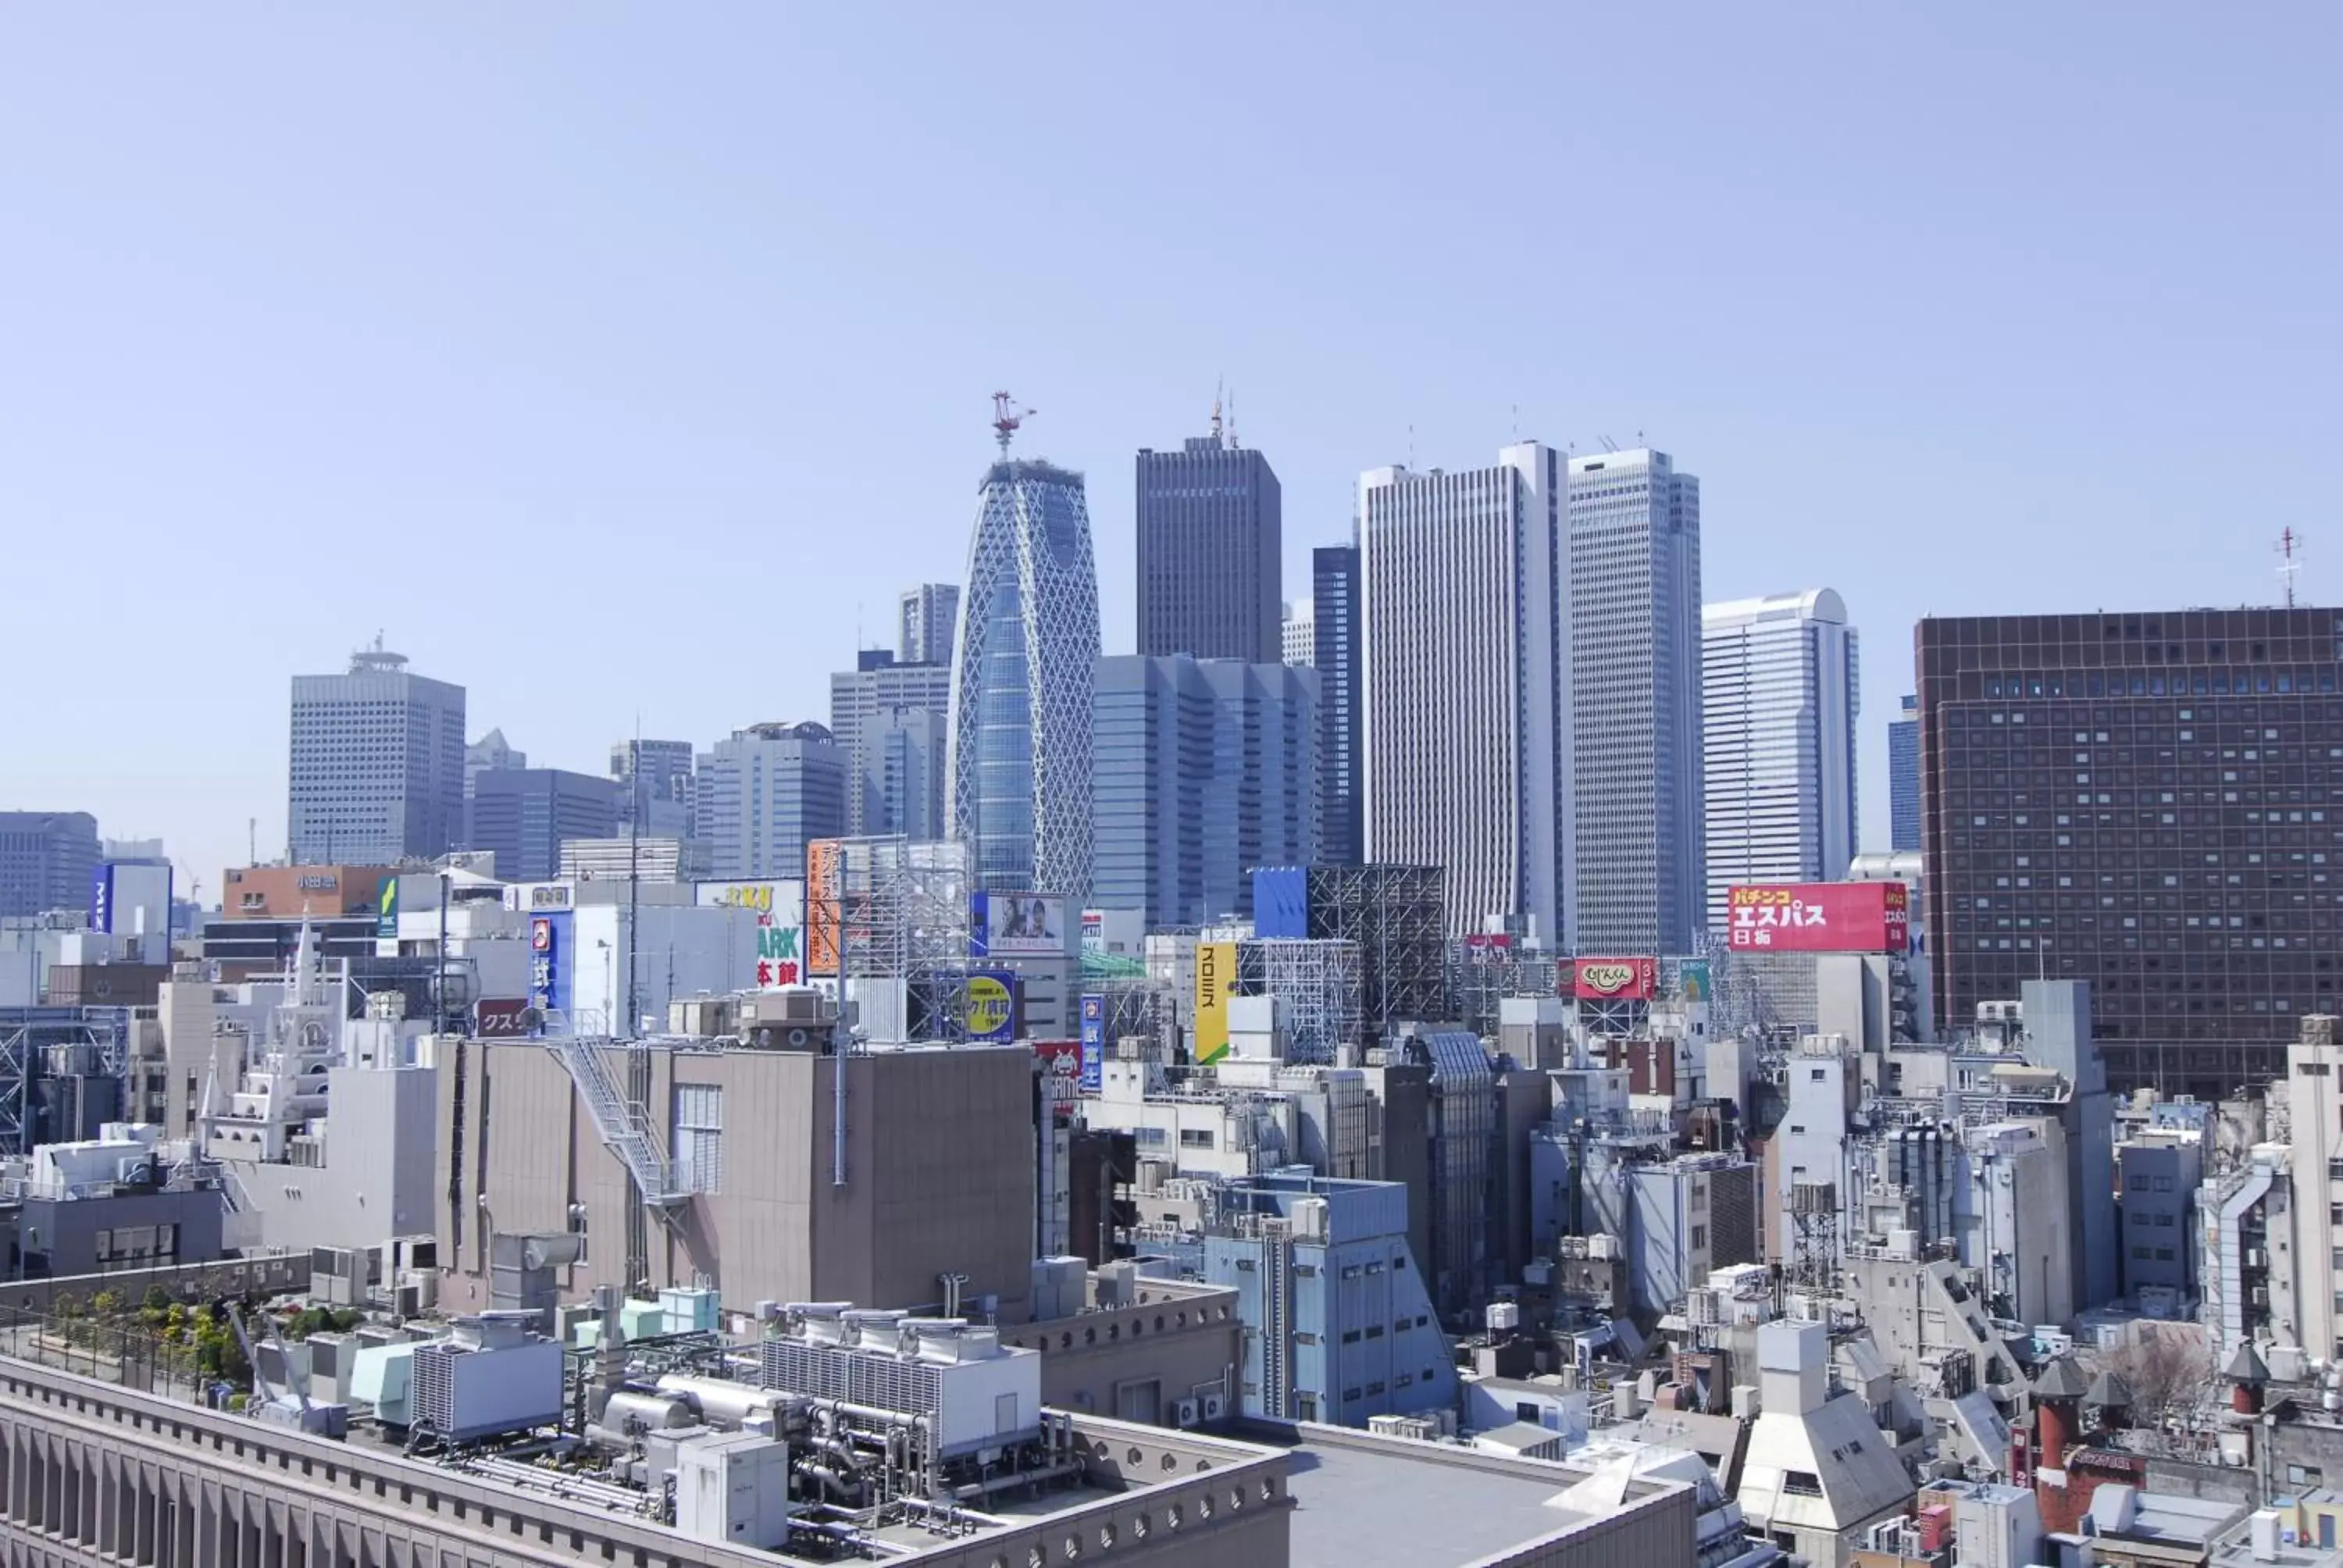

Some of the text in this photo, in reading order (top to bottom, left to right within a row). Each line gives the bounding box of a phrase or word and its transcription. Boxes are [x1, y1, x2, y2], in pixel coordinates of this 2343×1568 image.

[1733, 888, 1790, 905] パチンコ
[1734, 900, 1827, 928] エスパス
